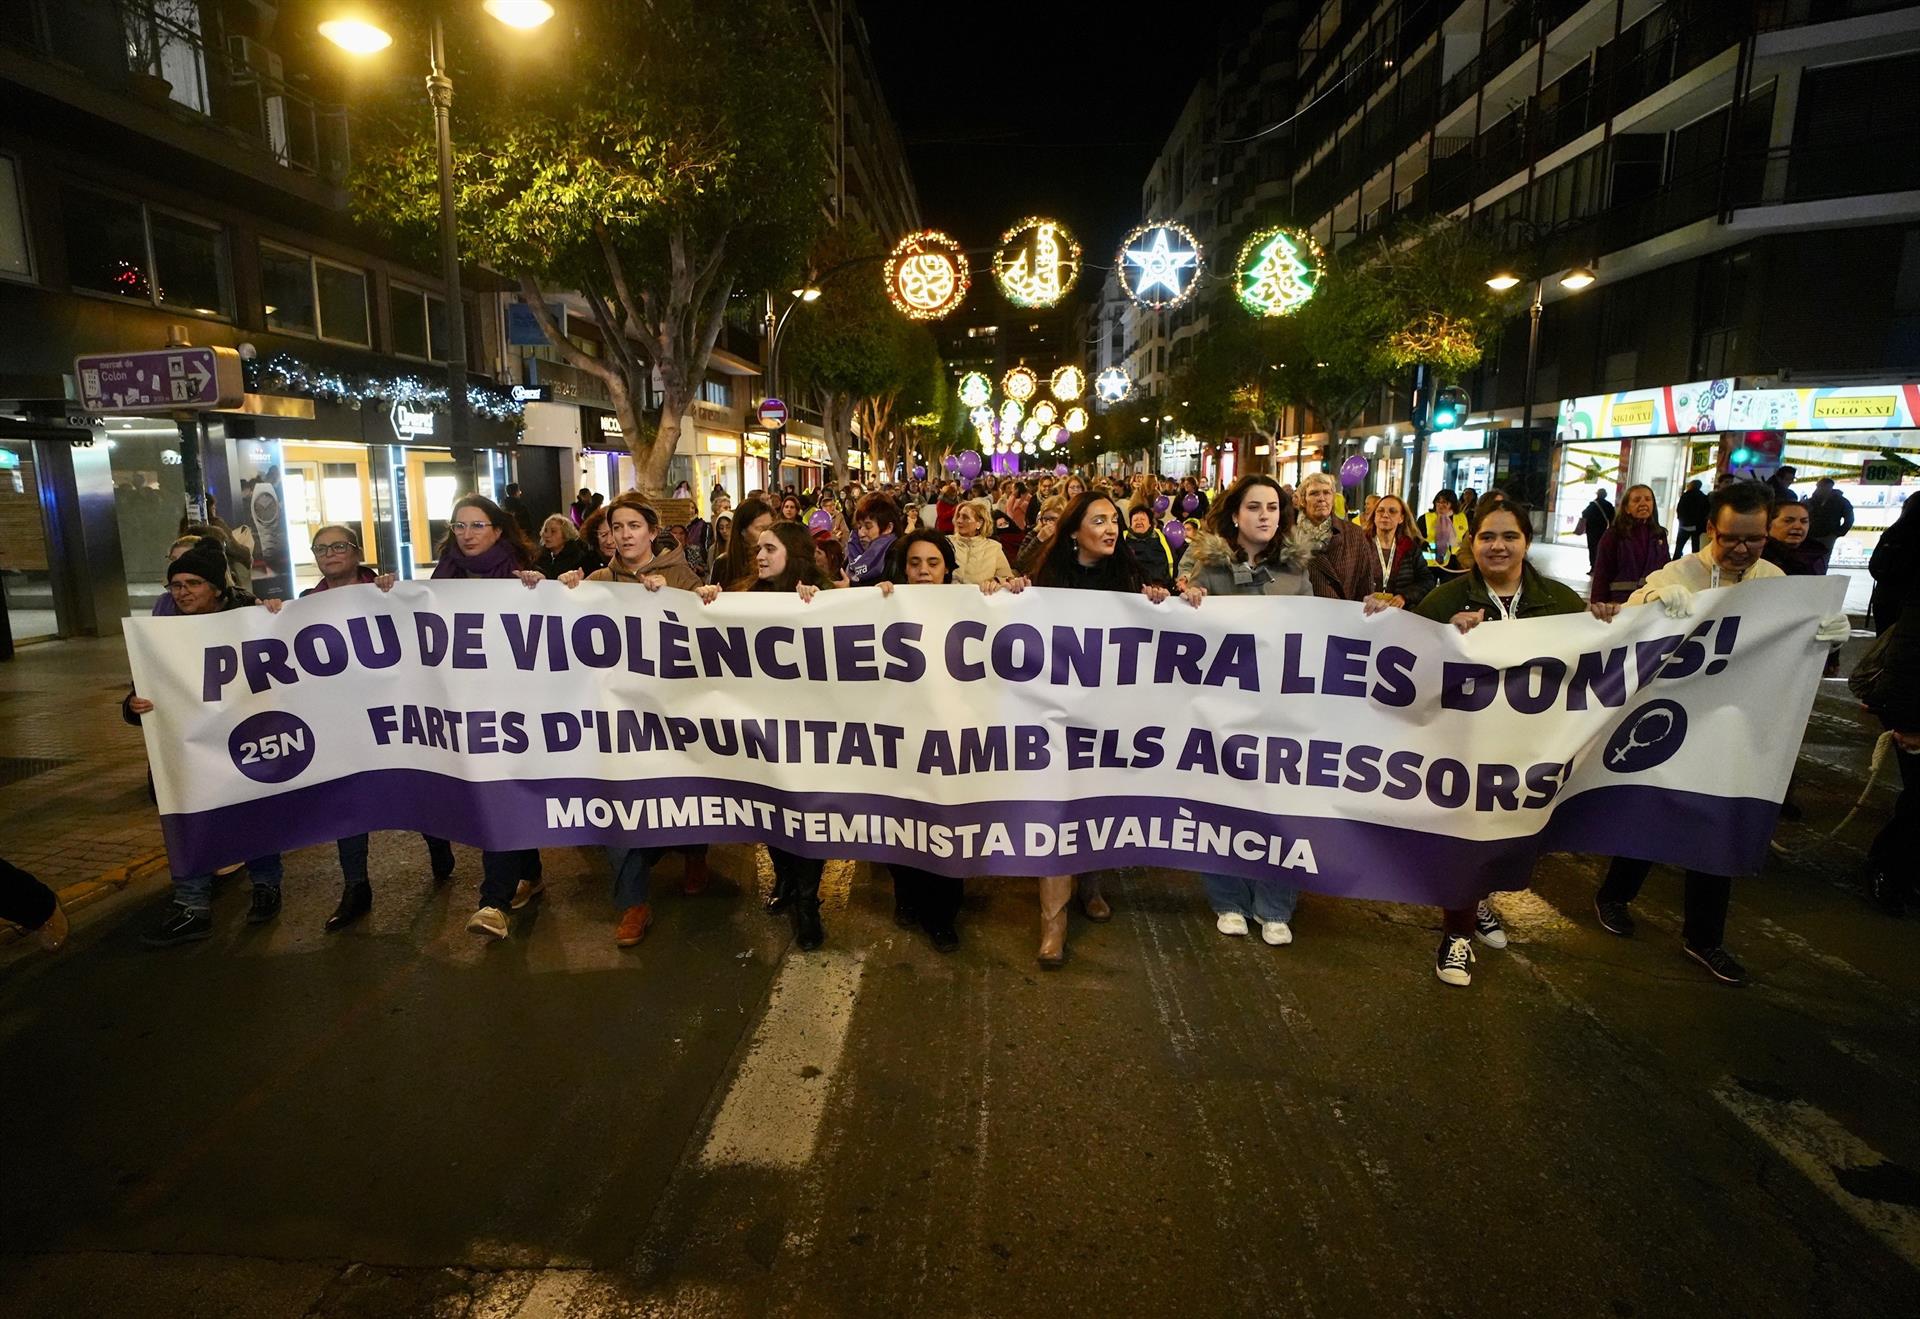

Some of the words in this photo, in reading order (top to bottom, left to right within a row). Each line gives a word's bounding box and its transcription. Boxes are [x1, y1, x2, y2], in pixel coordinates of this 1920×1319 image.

[1817, 407, 1858, 415] SIGLO
[1864, 406, 1891, 414] XXI
[203, 612, 402, 702] PROU
[414, 612, 487, 669] DE
[500, 610, 927, 683] VIOLÈNCIES
[945, 621, 1260, 692] CONTRA
[1281, 634, 1417, 708] LES
[240, 727, 306, 765] 25N
[367, 705, 526, 754] FARTES
[541, 709, 904, 769] D'IMPUNITAT
[917, 725, 1051, 775] AMB
[1066, 726, 1165, 770] ELS
[546, 797, 775, 831] MOVIMENT
[783, 808, 1016, 860] FEMINISTA
[1025, 823, 1078, 856] DE
[1086, 806, 1318, 875] VALÈNCIA
